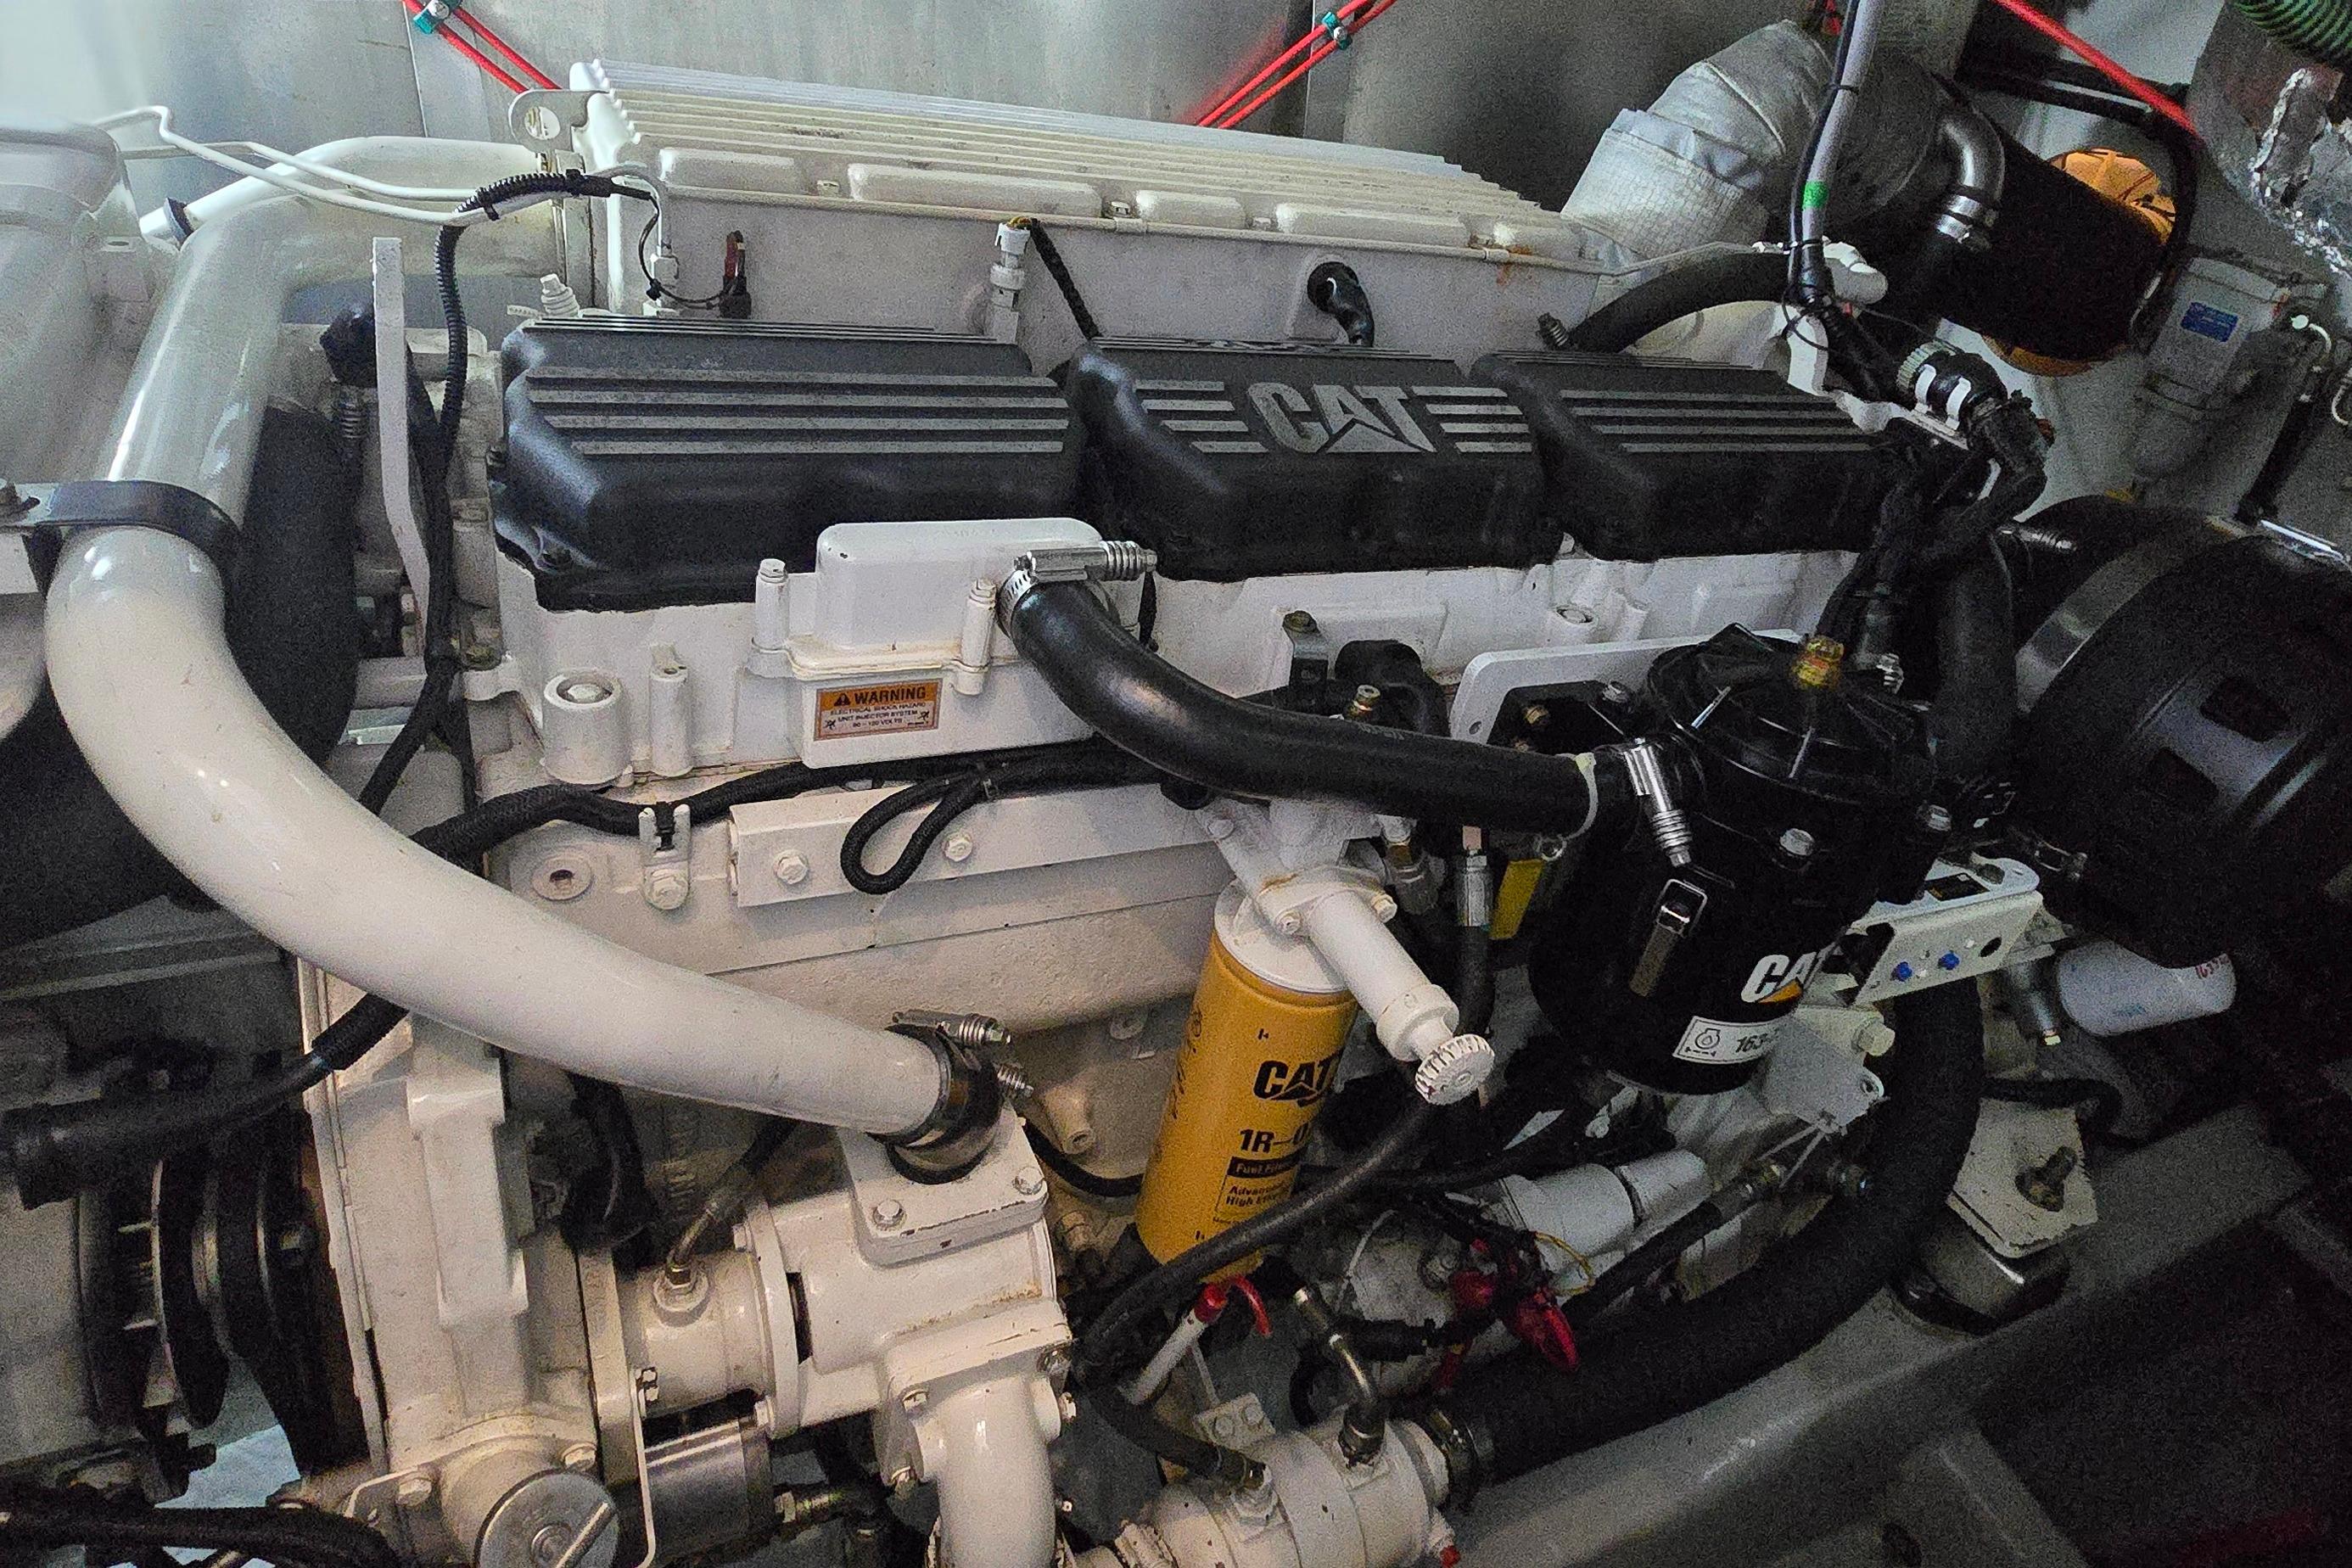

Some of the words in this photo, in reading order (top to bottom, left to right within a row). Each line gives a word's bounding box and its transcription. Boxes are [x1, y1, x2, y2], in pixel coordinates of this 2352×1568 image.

[1247, 382, 1437, 453] CAT
[854, 686, 927, 705] WARNING
[837, 714, 854, 723] UNIT
[855, 712, 890, 721] INJECTOR
[891, 709, 918, 719] SYSTEM
[1240, 1122, 1310, 1154] 1R-0
[1236, 1162, 1263, 1173] Fuel
[1226, 1196, 1253, 1207] High
